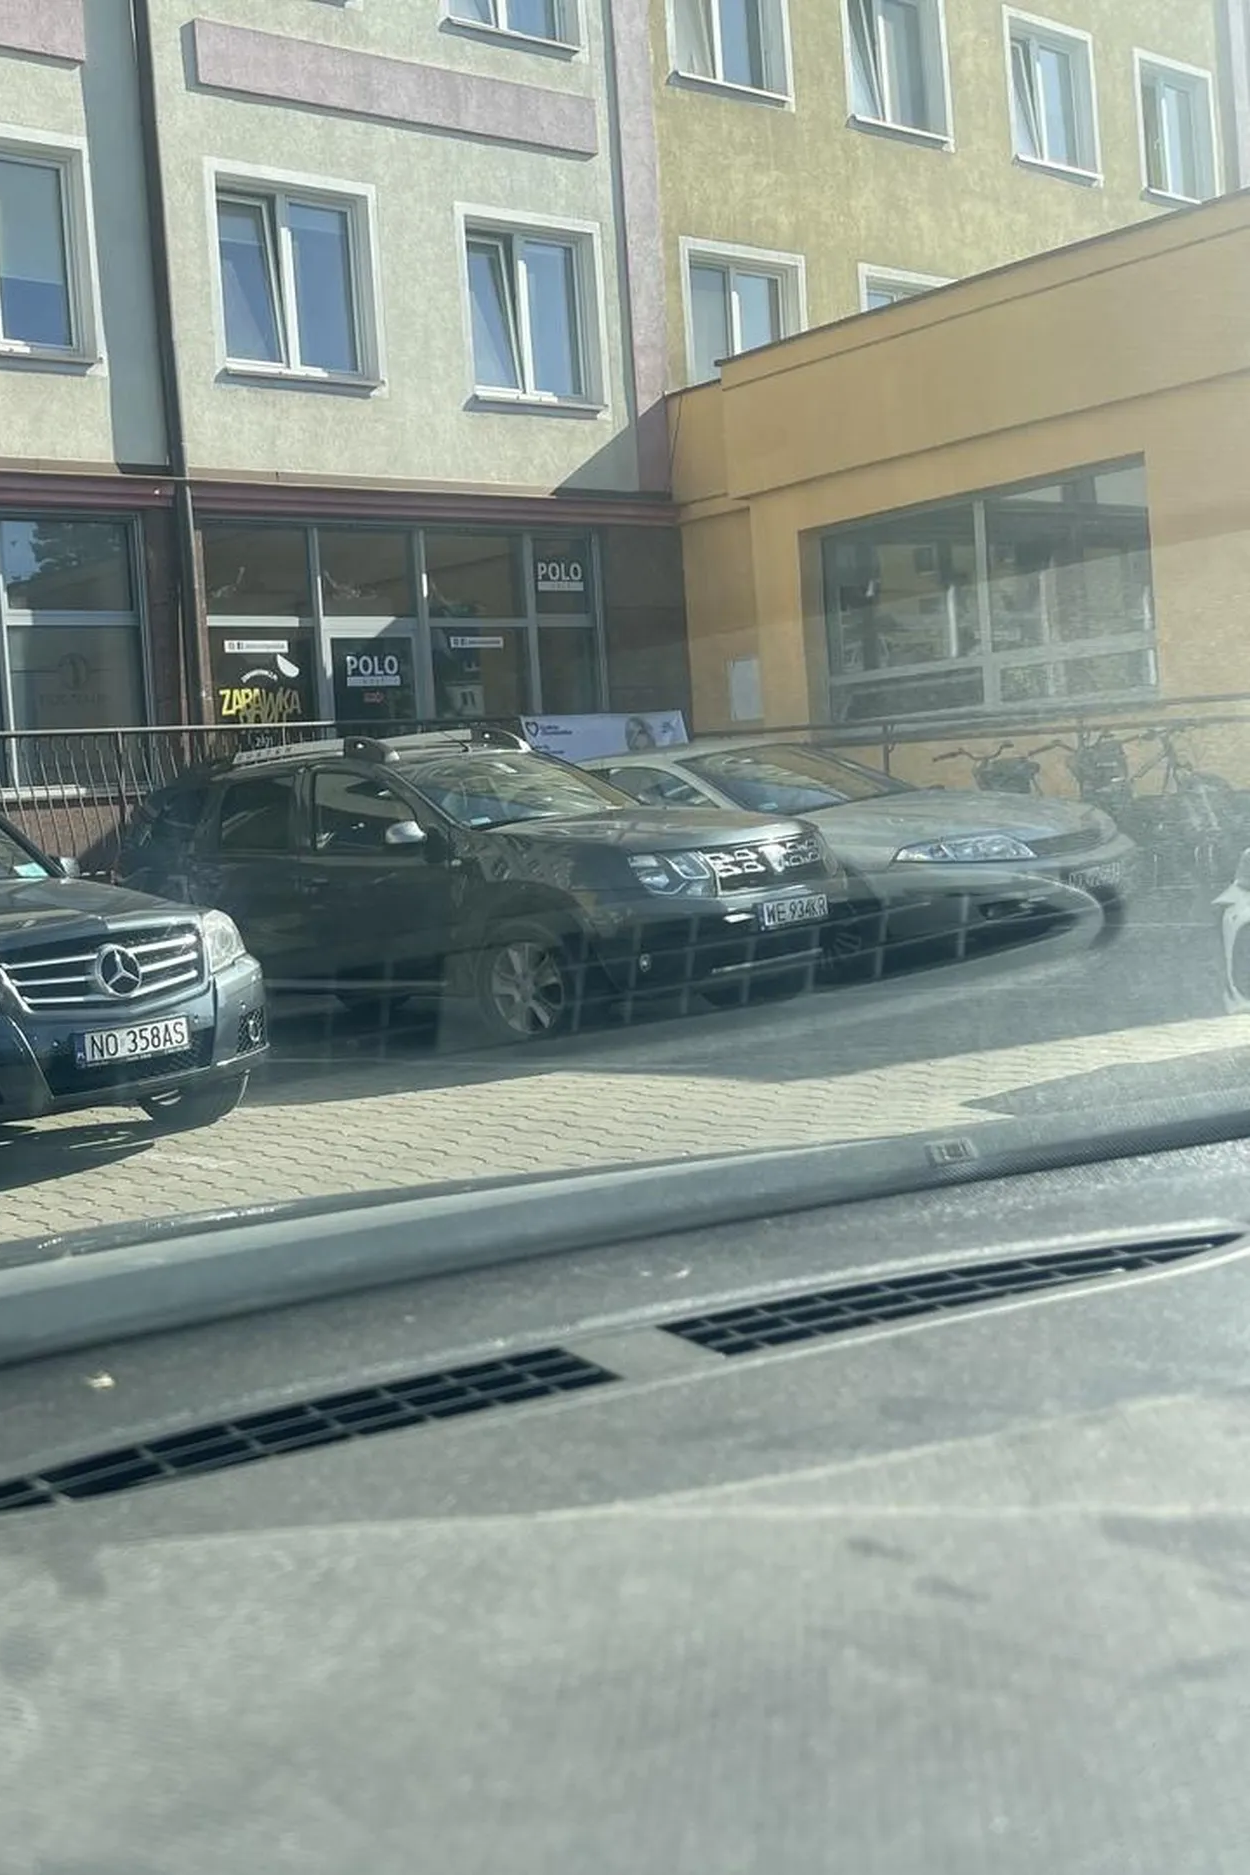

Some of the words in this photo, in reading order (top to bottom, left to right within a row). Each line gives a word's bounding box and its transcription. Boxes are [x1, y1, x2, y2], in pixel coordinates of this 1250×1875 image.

[537, 562, 582, 580] POLO
[346, 655, 399, 676] POLO
[765, 902, 786, 924] WE
[91, 1033, 119, 1058] NO
[126, 1021, 185, 1053] 358AS
